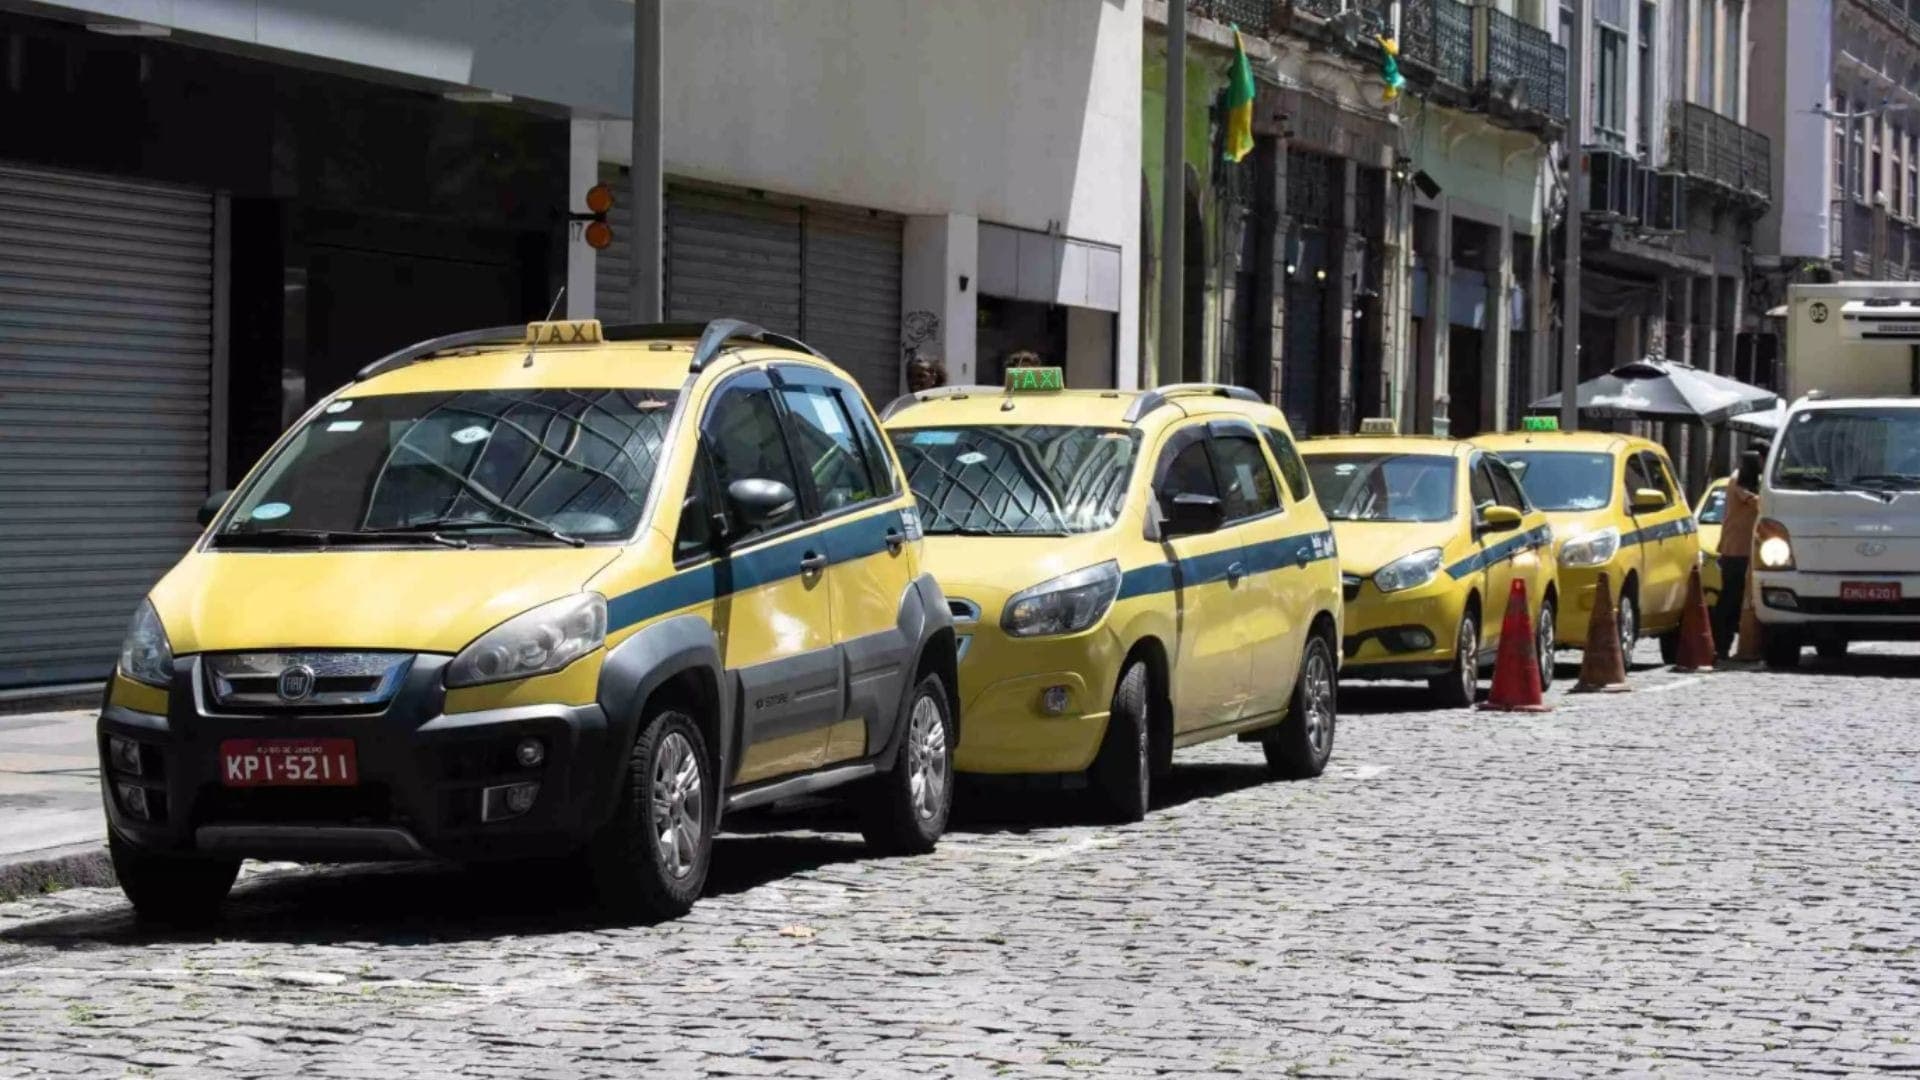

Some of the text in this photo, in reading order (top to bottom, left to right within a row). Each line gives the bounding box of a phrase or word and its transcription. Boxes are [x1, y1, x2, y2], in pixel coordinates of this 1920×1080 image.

[529, 323, 600, 344] TAXI
[1007, 367, 1060, 389] TAXI
[1524, 416, 1558, 429] TAXI
